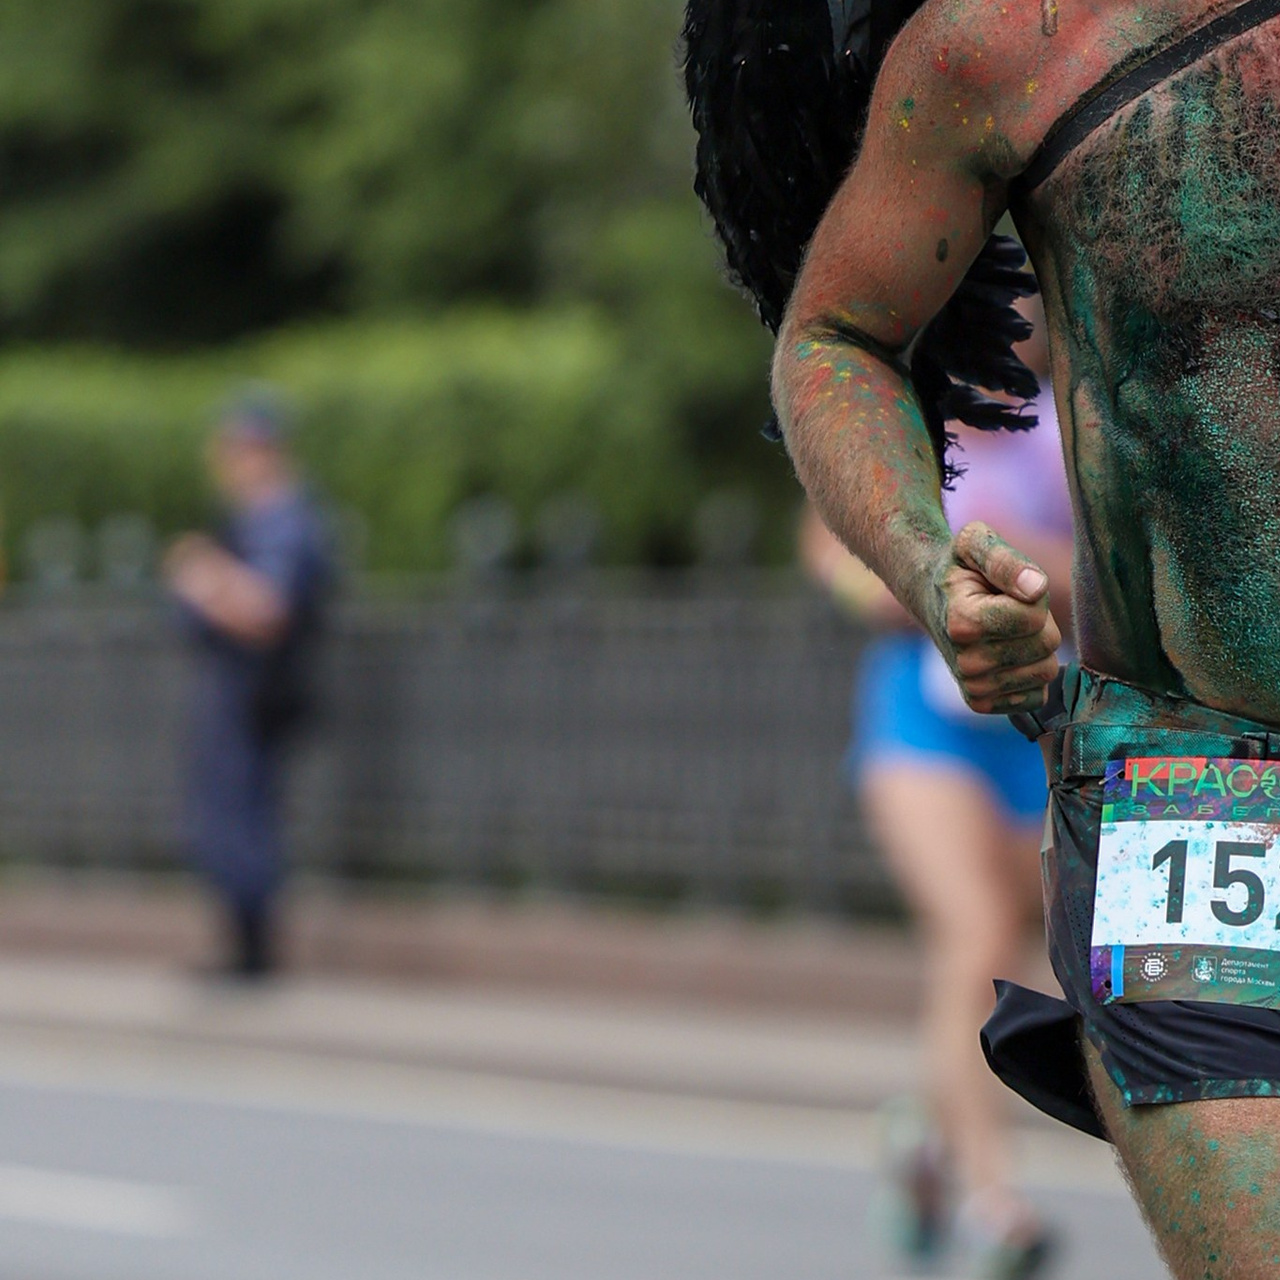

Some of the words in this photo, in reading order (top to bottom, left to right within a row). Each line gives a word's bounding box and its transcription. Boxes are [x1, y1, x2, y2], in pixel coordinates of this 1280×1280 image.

[1220, 957, 1269, 969] Департамент
[1220, 967, 1247, 976] спорта
[1220, 975, 1246, 984] города
